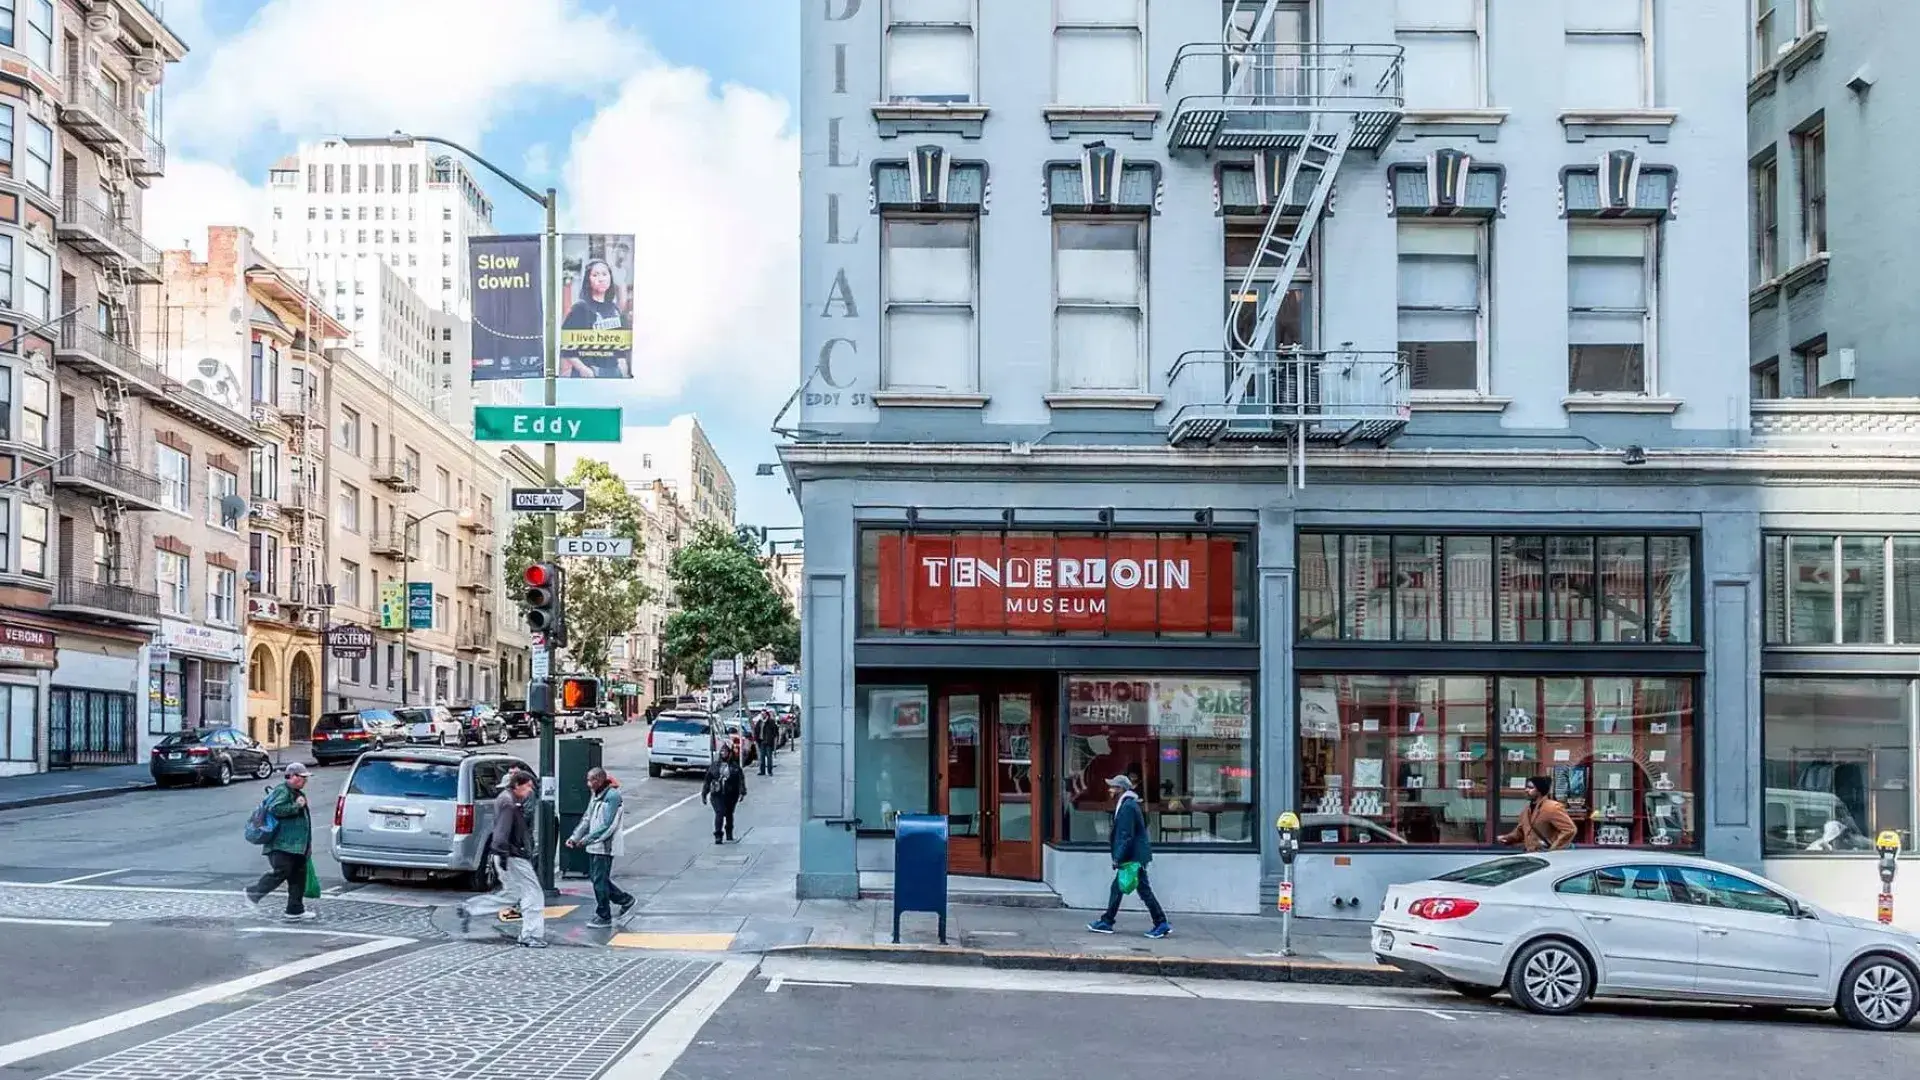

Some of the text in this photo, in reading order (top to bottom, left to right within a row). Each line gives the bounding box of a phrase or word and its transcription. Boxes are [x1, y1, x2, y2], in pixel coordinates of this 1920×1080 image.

[478, 254, 519, 269] Slow
[478, 272, 530, 289] down!
[577, 331, 595, 342] live
[805, 393, 866, 406] EDDY ST
[513, 415, 581, 438] Eddy
[518, 495, 562, 505] ONE WAY
[568, 541, 620, 553] EDDY
[922, 557, 1190, 590] TENDERLOIN
[1006, 598, 1107, 613] MUSEUM
[5, 627, 45, 644] VERONA
[328, 633, 371, 646] WESTERN
[787, 684, 800, 692] 25
